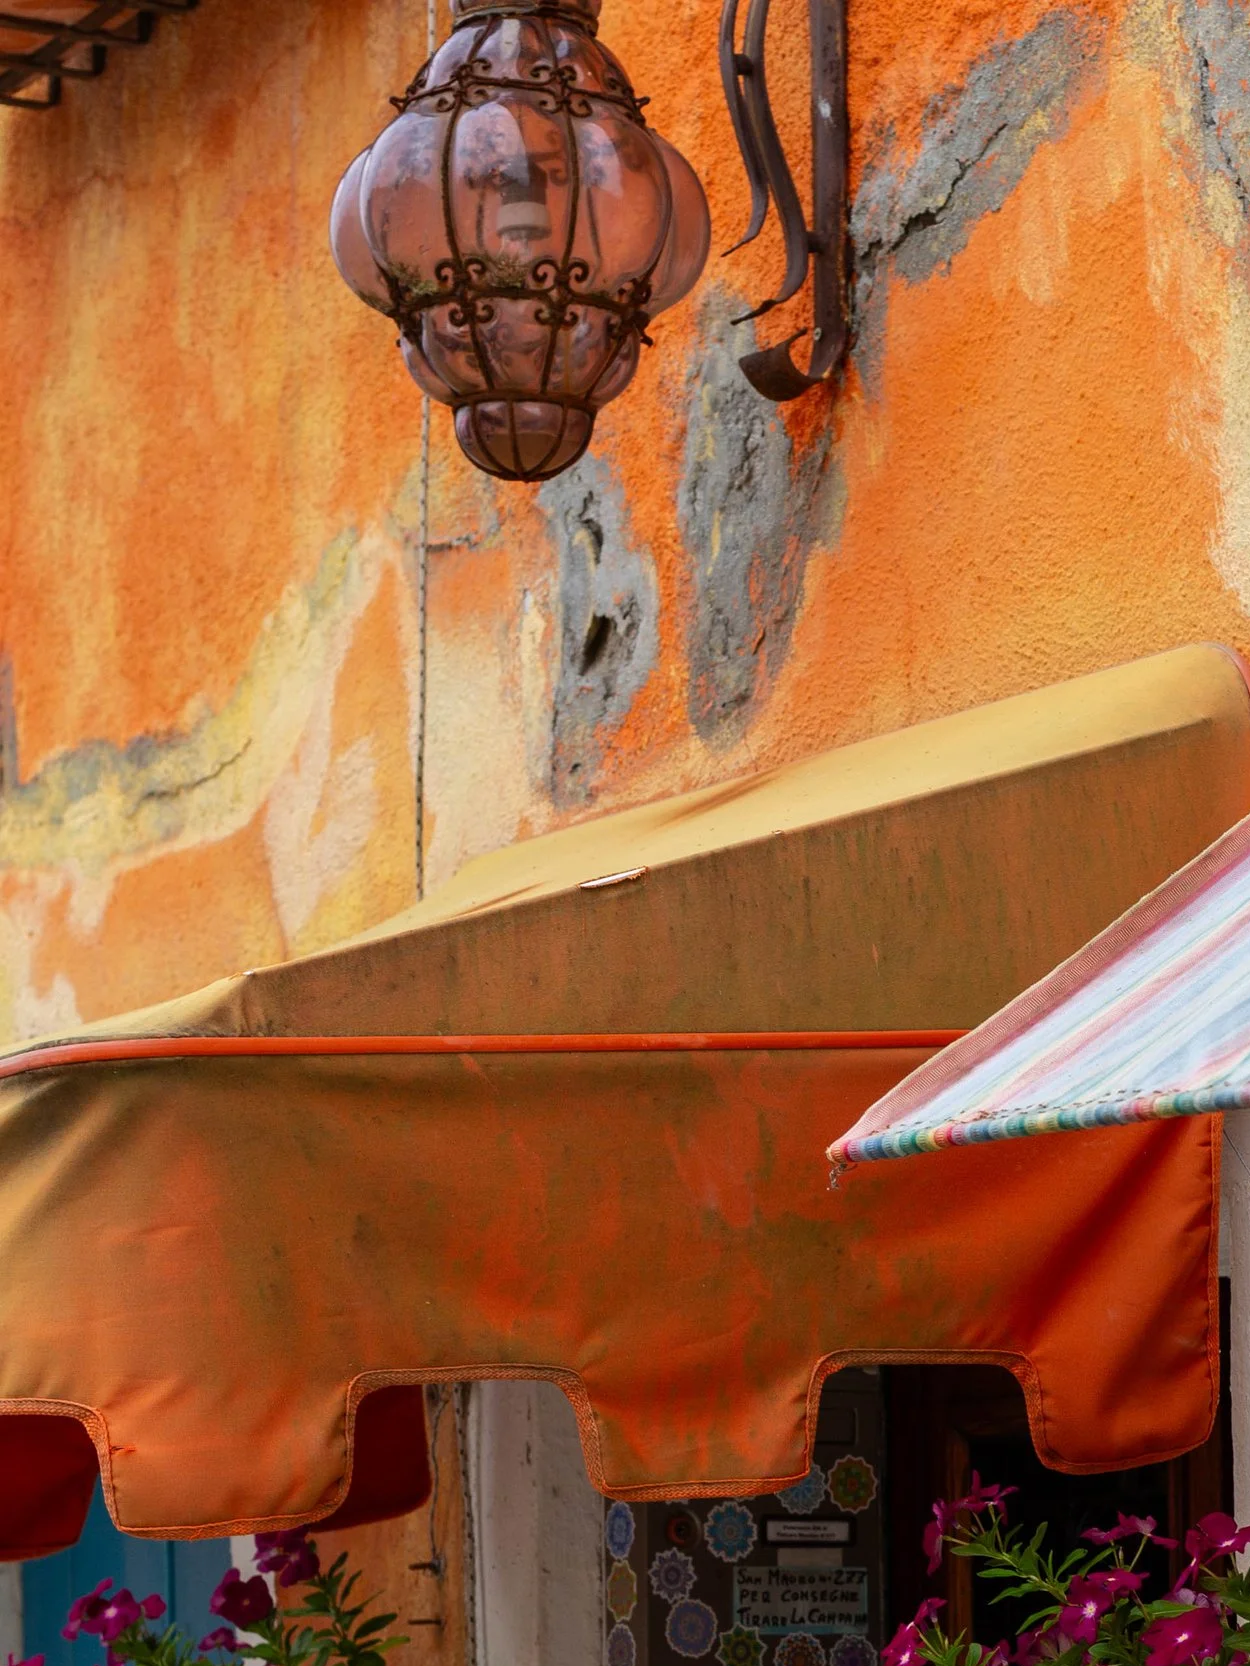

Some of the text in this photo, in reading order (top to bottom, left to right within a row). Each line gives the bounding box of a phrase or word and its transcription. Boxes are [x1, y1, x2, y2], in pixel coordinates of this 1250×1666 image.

[833, 1569, 867, 1585] 277
[739, 1589, 860, 1604] PER CONSEGNE
